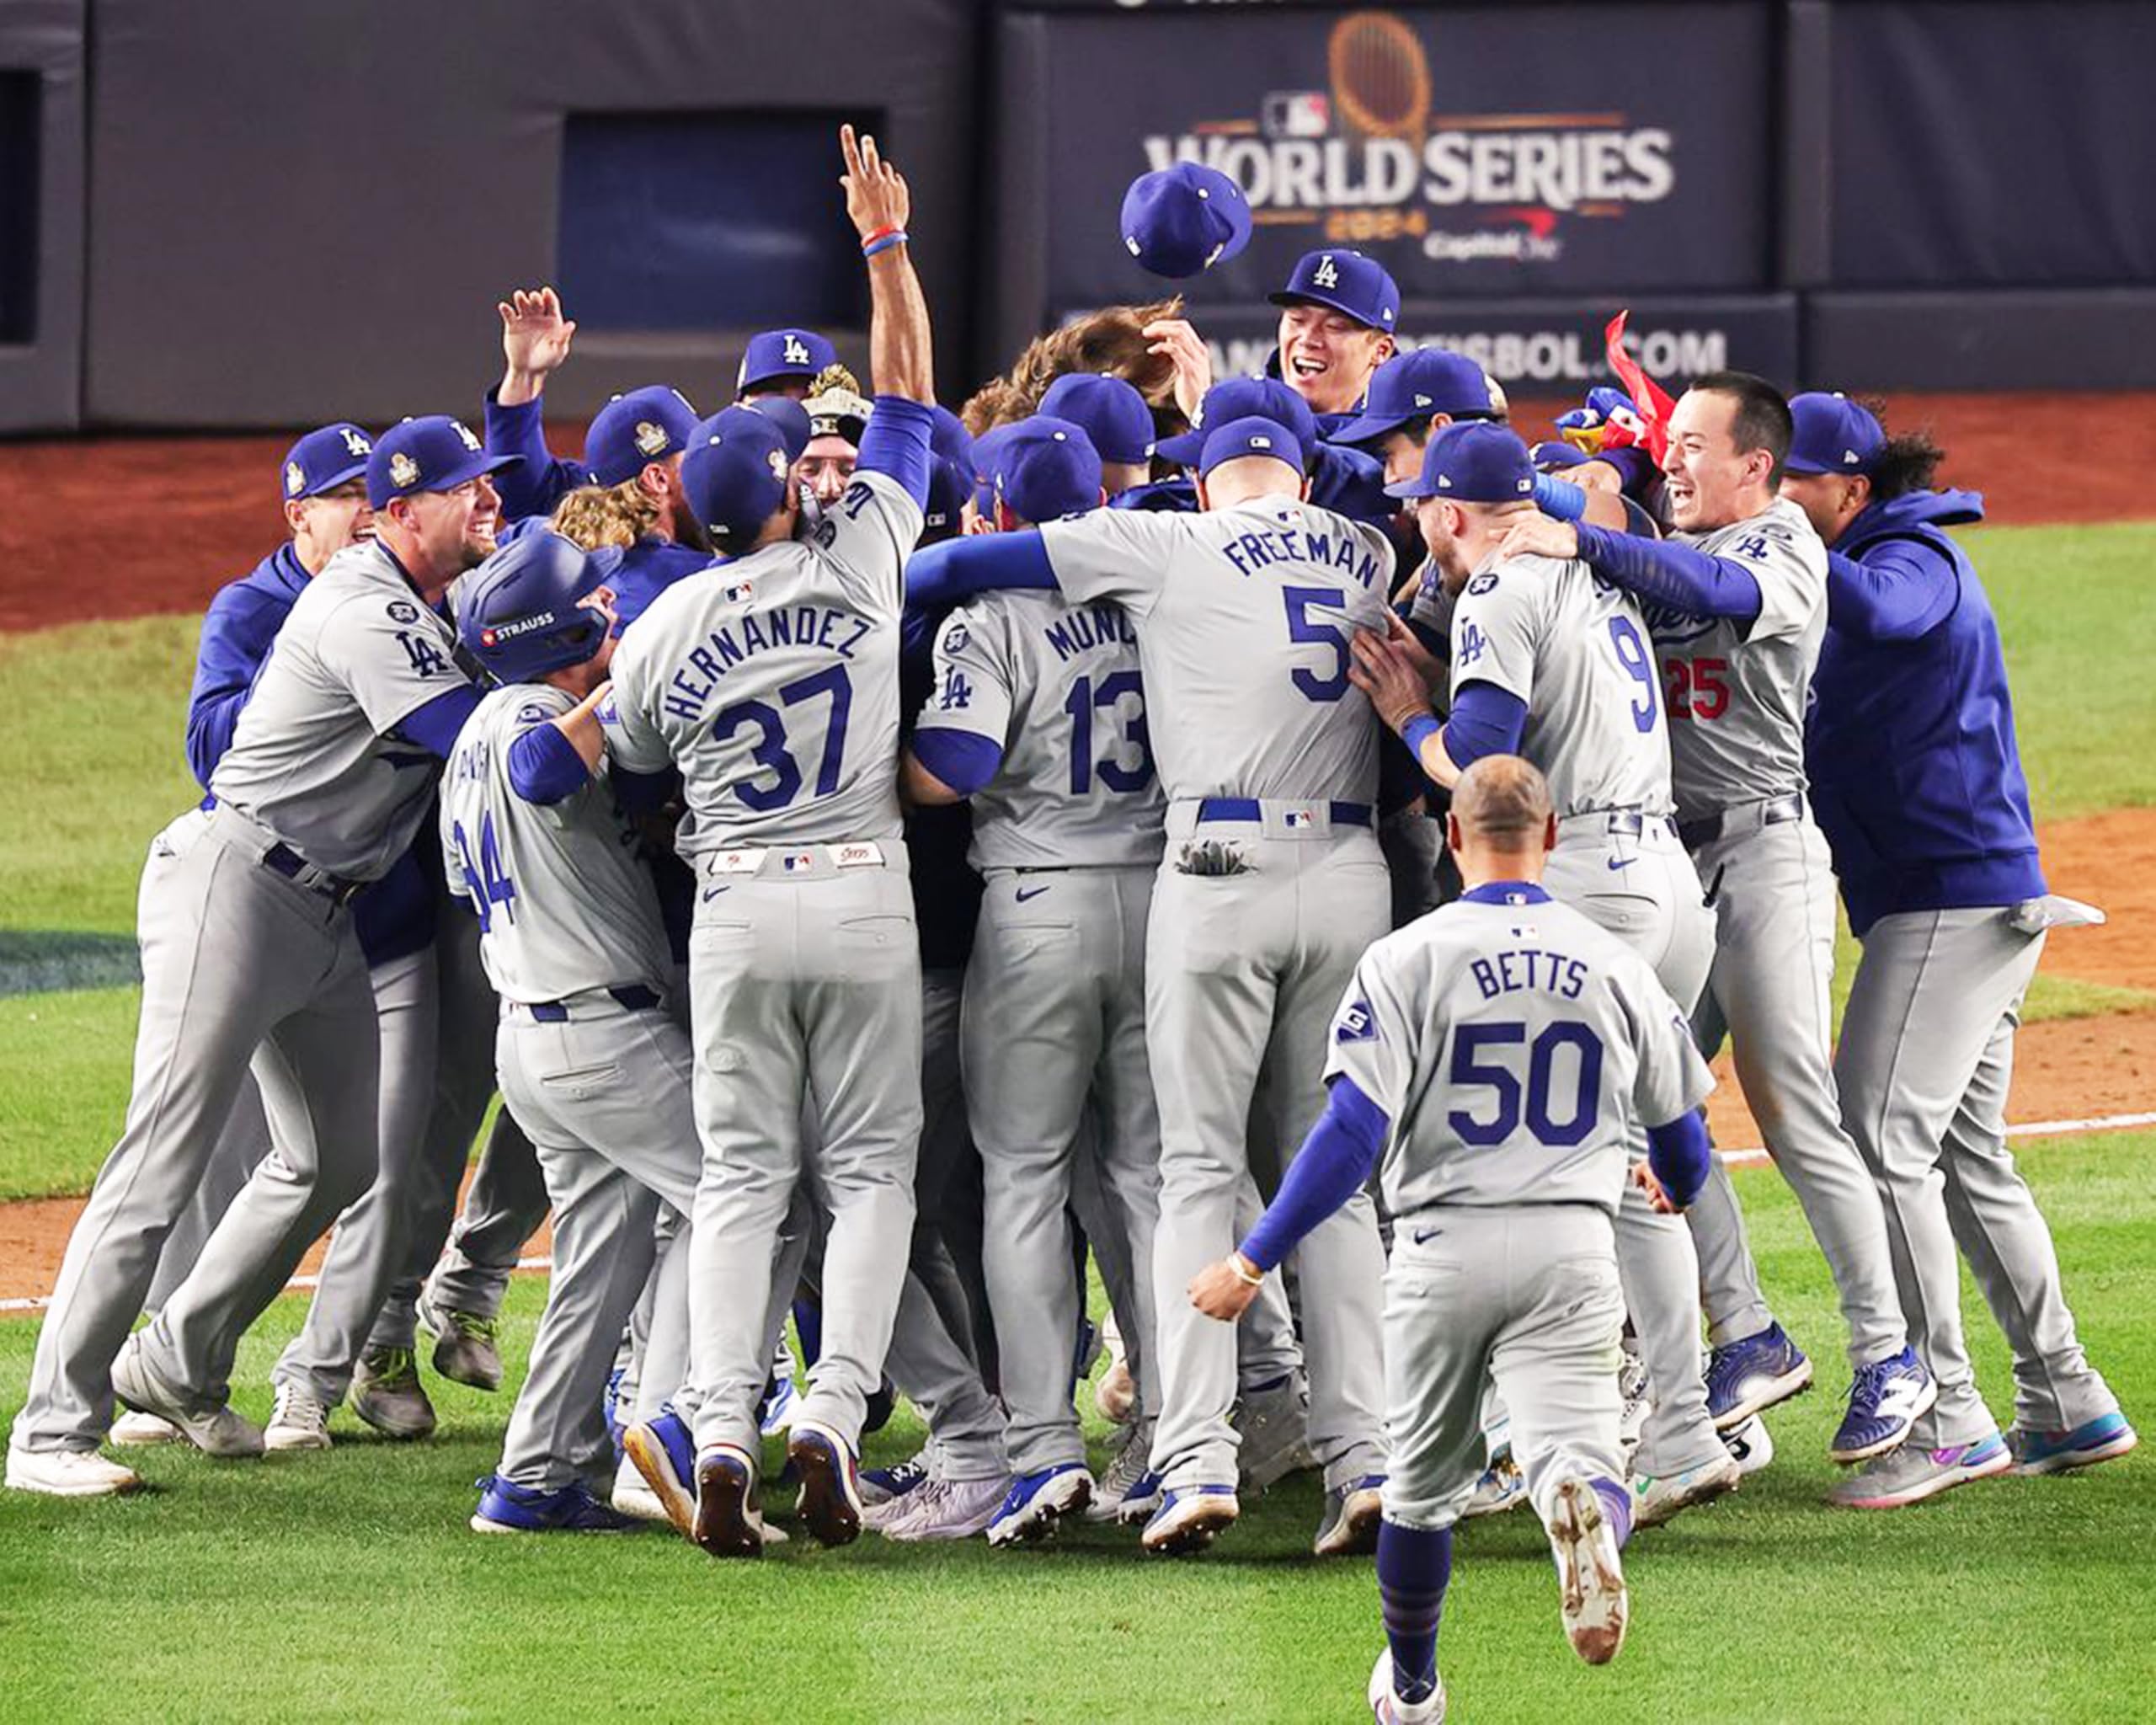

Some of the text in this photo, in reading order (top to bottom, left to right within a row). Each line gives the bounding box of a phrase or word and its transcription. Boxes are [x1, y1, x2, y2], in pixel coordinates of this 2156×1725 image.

[1424, 129, 1674, 211] SERIES
[1312, 254, 1338, 290] LA
[783, 334, 809, 365] LA
[339, 428, 372, 457] LA
[1222, 529, 1380, 589] FREEMAN
[395, 632, 449, 677] LA
[496, 611, 555, 641] STRAUSS
[1283, 585, 1348, 702] 5
[1460, 616, 1486, 667] LA
[664, 606, 871, 721] HERNÁNDEZ
[940, 664, 973, 710] LA
[1609, 616, 1657, 733] 9
[1666, 656, 1731, 719] 25
[712, 662, 853, 812] 37
[1065, 670, 1155, 794] 13
[1470, 949, 1588, 1000] BETTS
[1448, 1021, 1604, 1146] 50
